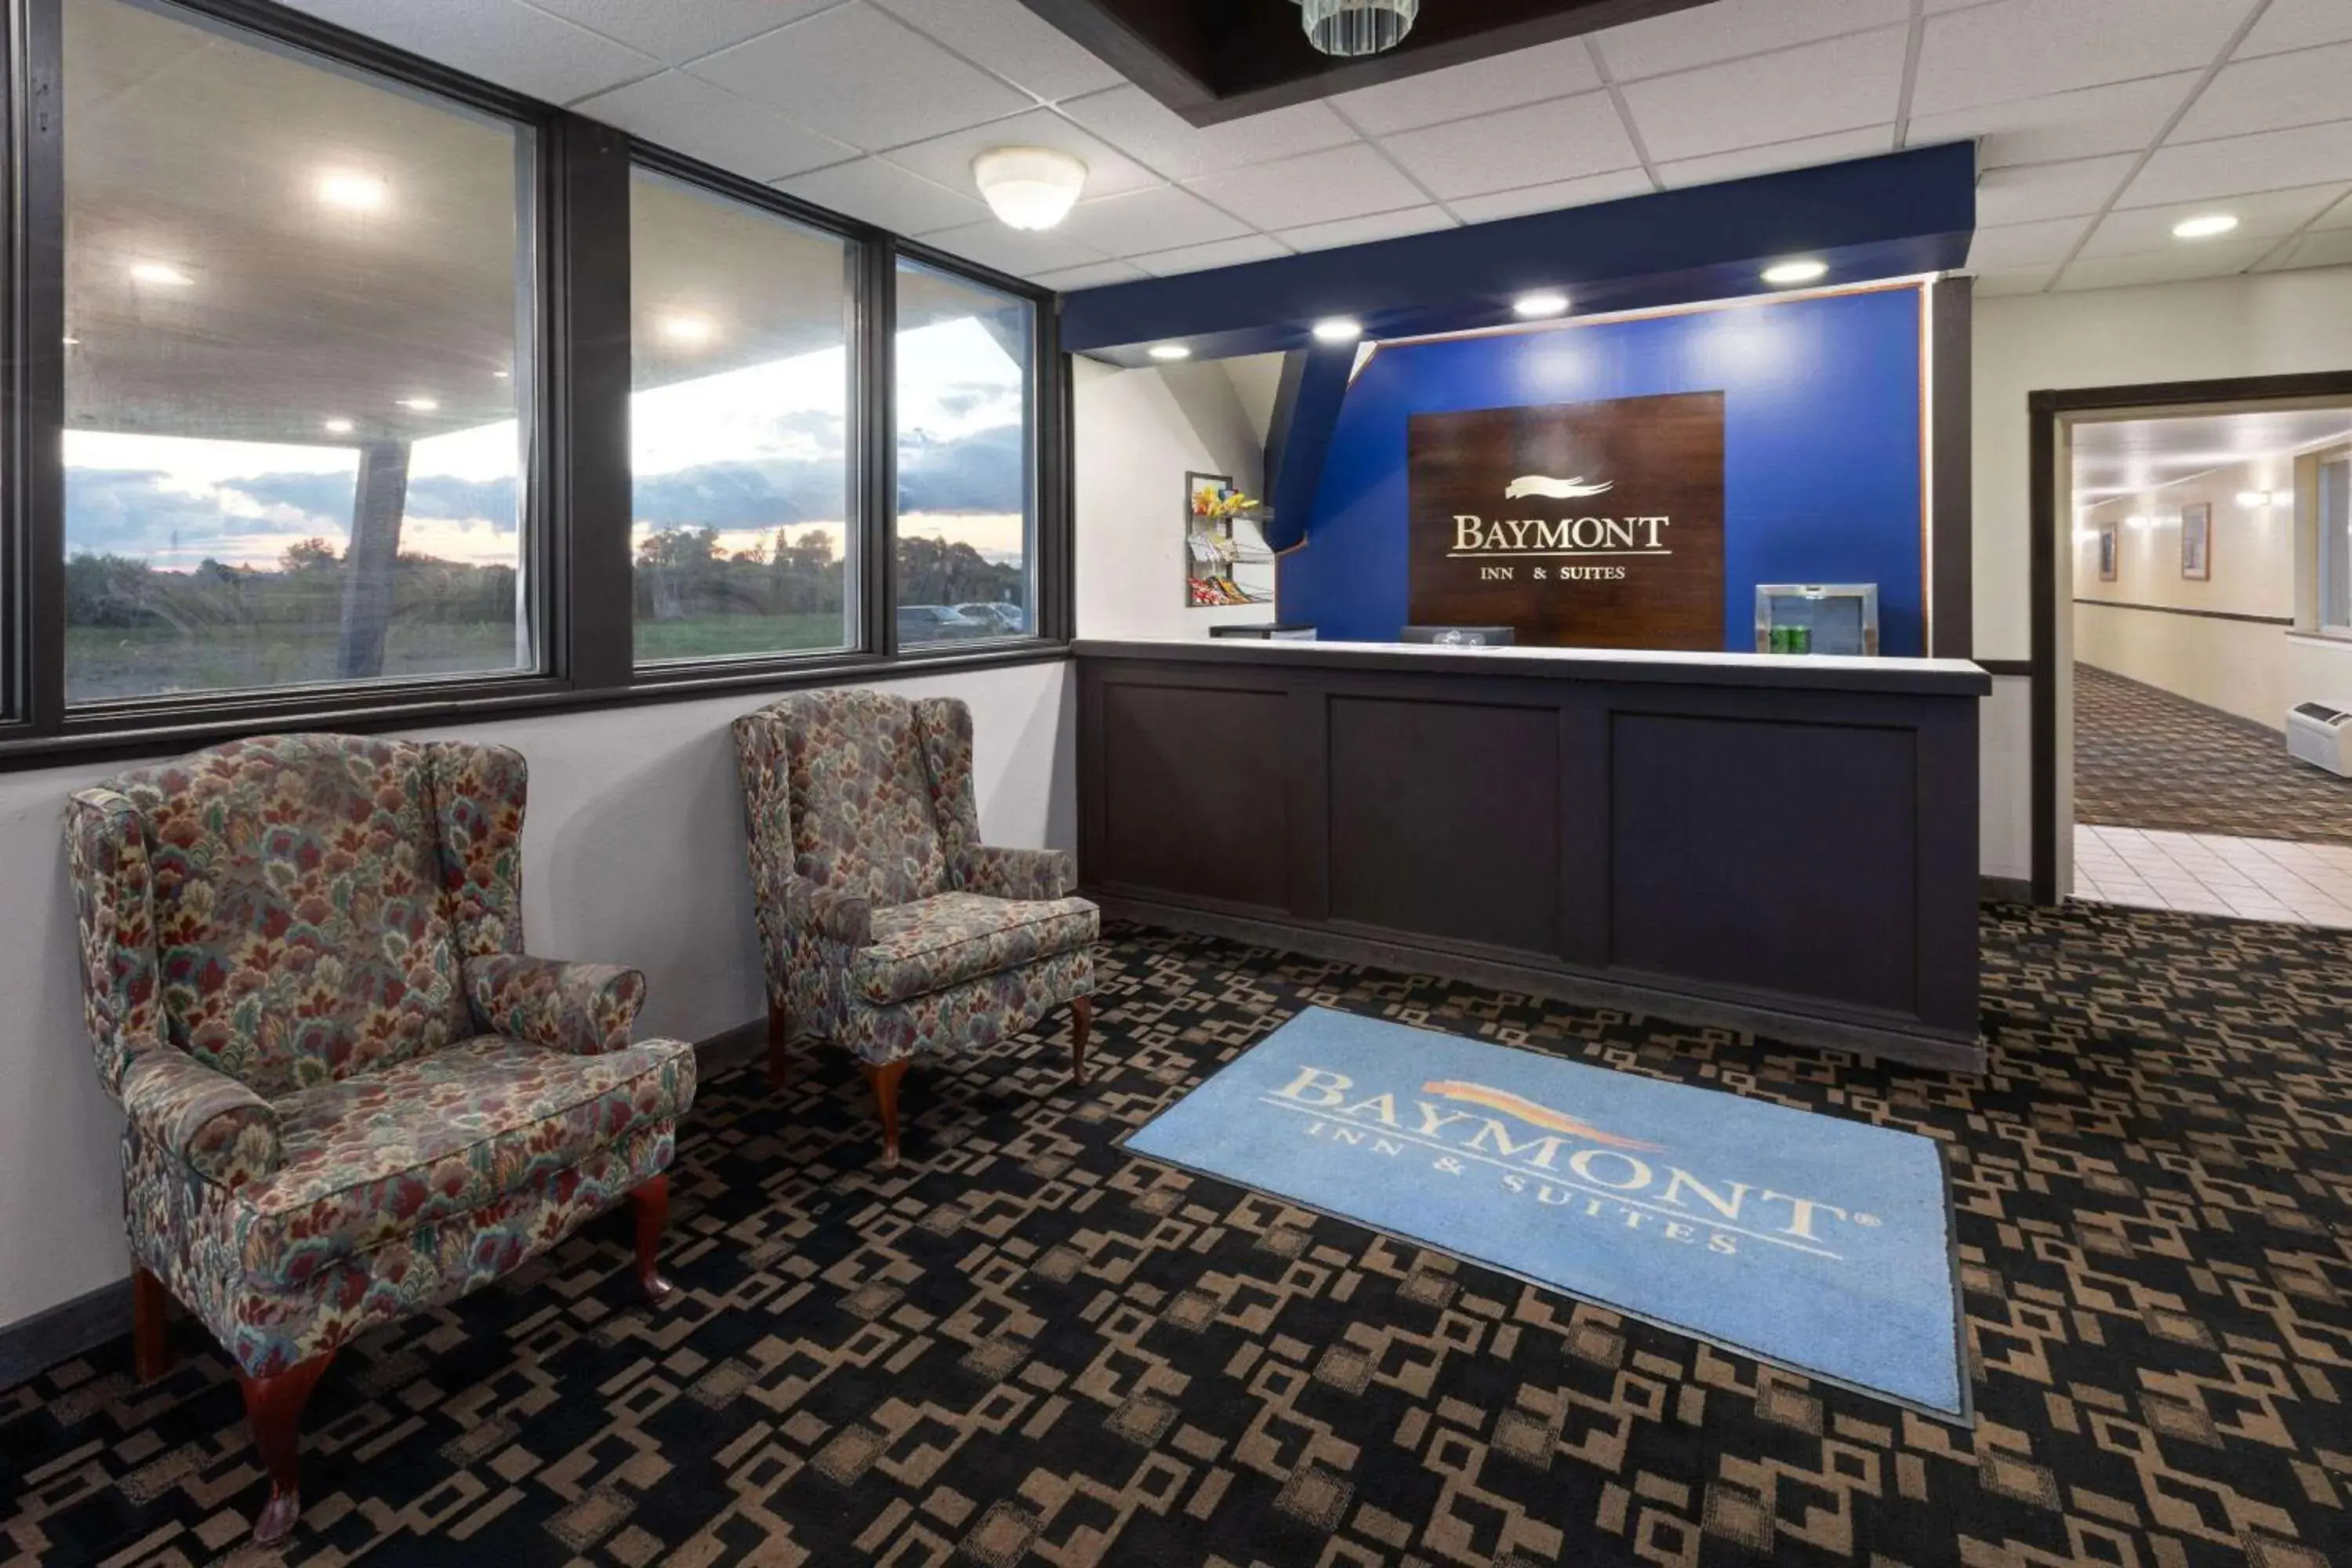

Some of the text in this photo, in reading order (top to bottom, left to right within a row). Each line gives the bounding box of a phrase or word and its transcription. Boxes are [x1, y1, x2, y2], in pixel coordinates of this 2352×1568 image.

[1452, 514, 1669, 550] BAYMONT
[1480, 566, 1625, 580] INN & SUITES
[1308, 1122, 1738, 1255] INN & SUITES
